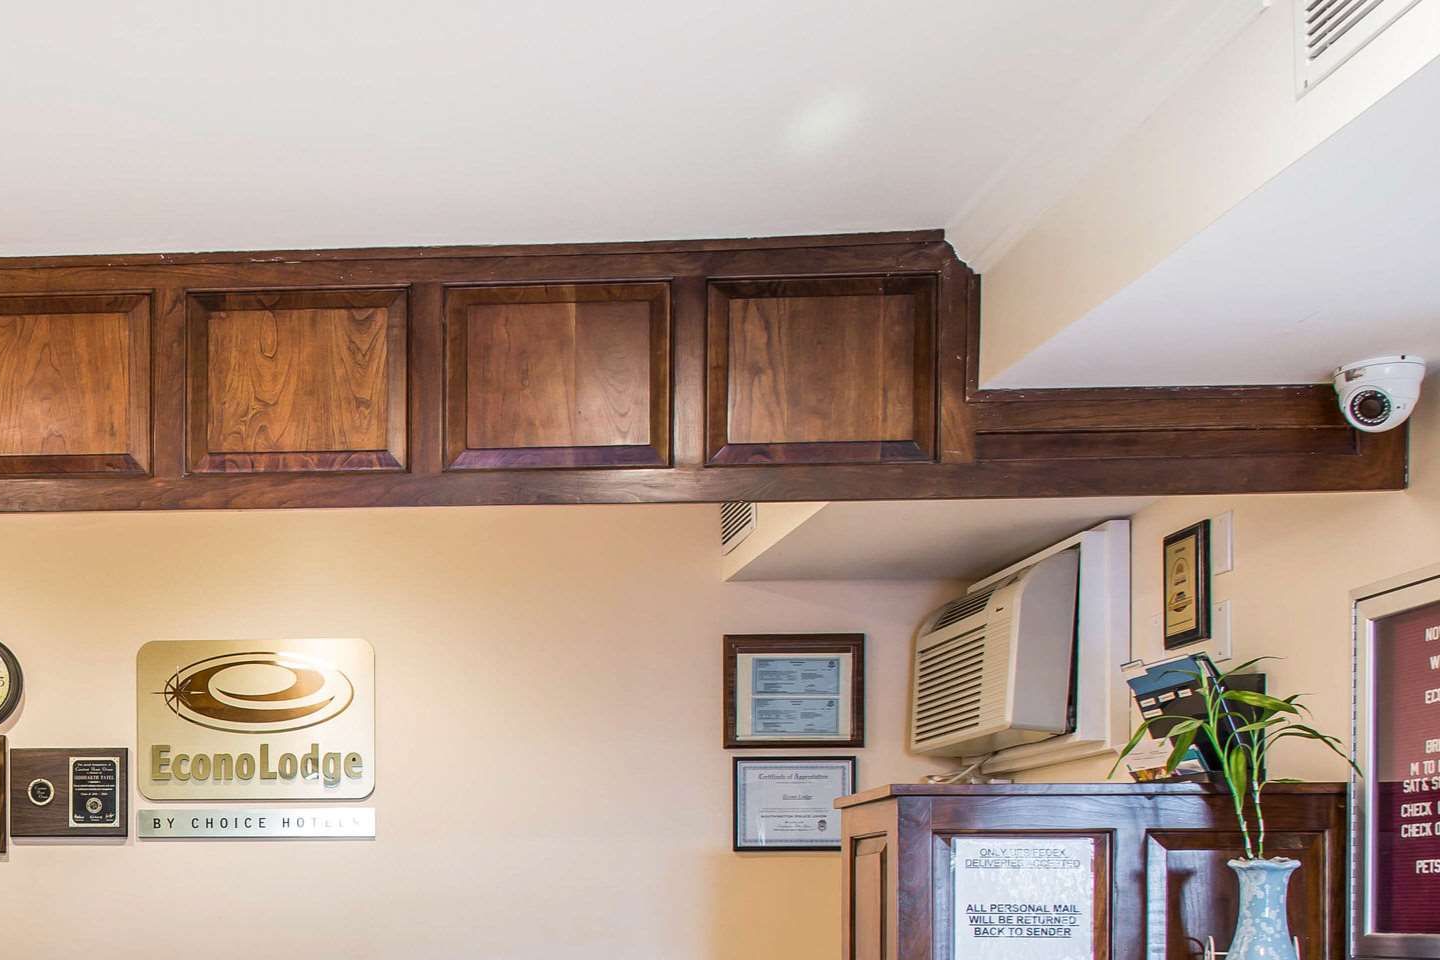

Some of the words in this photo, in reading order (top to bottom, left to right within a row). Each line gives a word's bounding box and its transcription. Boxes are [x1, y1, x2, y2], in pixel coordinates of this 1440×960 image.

[1425, 626, 1440, 641] NO
[1423, 760, 1435, 775] TO
[794, 773, 829, 781] Appreciation
[1401, 802, 1433, 817] CHECK
[153, 818, 175, 829] BY
[191, 817, 267, 829] CHOICE
[1401, 822, 1433, 838] CHECK
[979, 848, 1007, 857] ONLY
[1026, 858, 1080, 868] CCEPTED
[1415, 859, 1440, 875] PETS
[966, 904, 987, 913] ALL
[990, 904, 1049, 913] PERSONAL
[1053, 904, 1079, 913] MAIL
[969, 916, 994, 924] WILL
[998, 916, 1013, 924] BE
[1016, 916, 1077, 925] RETURNED
[974, 927, 1004, 936] BACK
[1009, 928, 1024, 936] TO
[1026, 927, 1072, 937] SENDER
